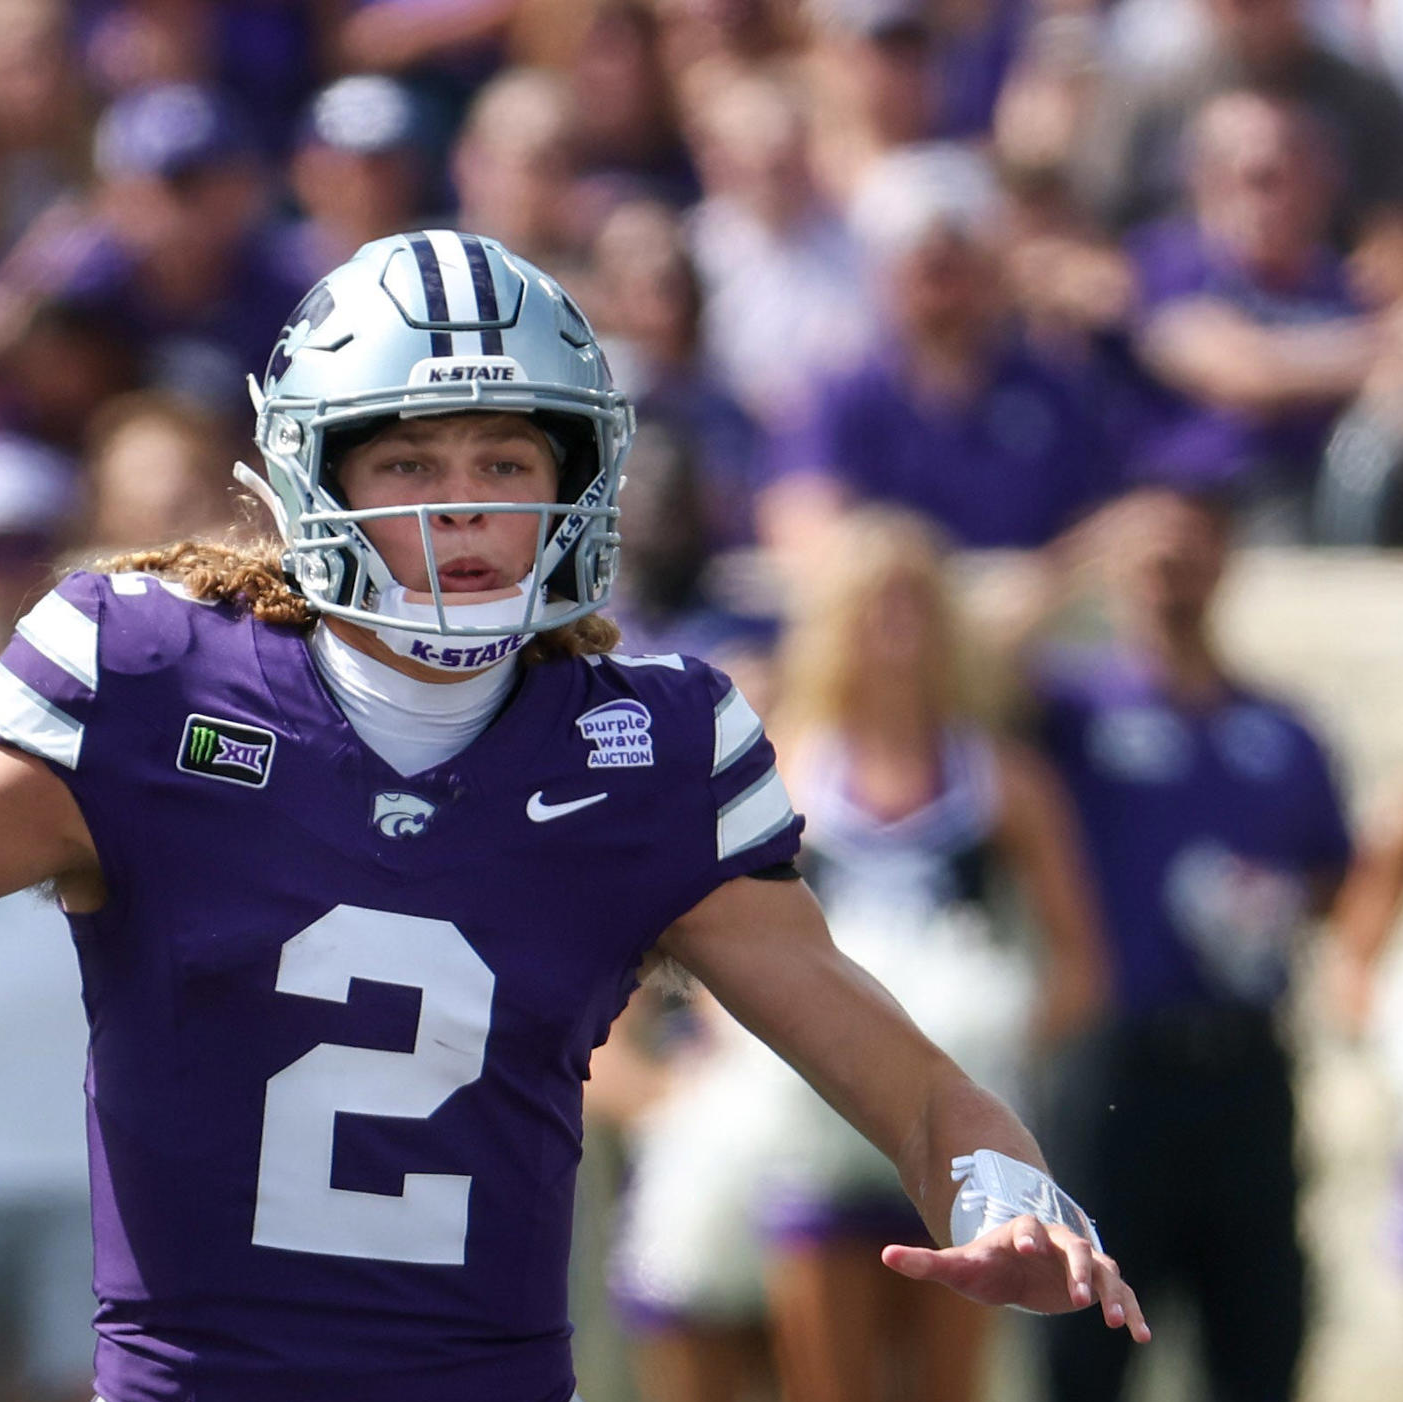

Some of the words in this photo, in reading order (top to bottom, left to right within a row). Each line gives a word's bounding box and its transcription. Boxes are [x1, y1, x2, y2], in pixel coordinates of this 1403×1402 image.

[429, 366, 515, 382] K-STATE
[410, 633, 525, 668] K-STATE
[582, 714, 646, 736] purple
[598, 734, 649, 748] wave
[590, 750, 652, 764] AUCTION
[251, 903, 496, 1266] 2
